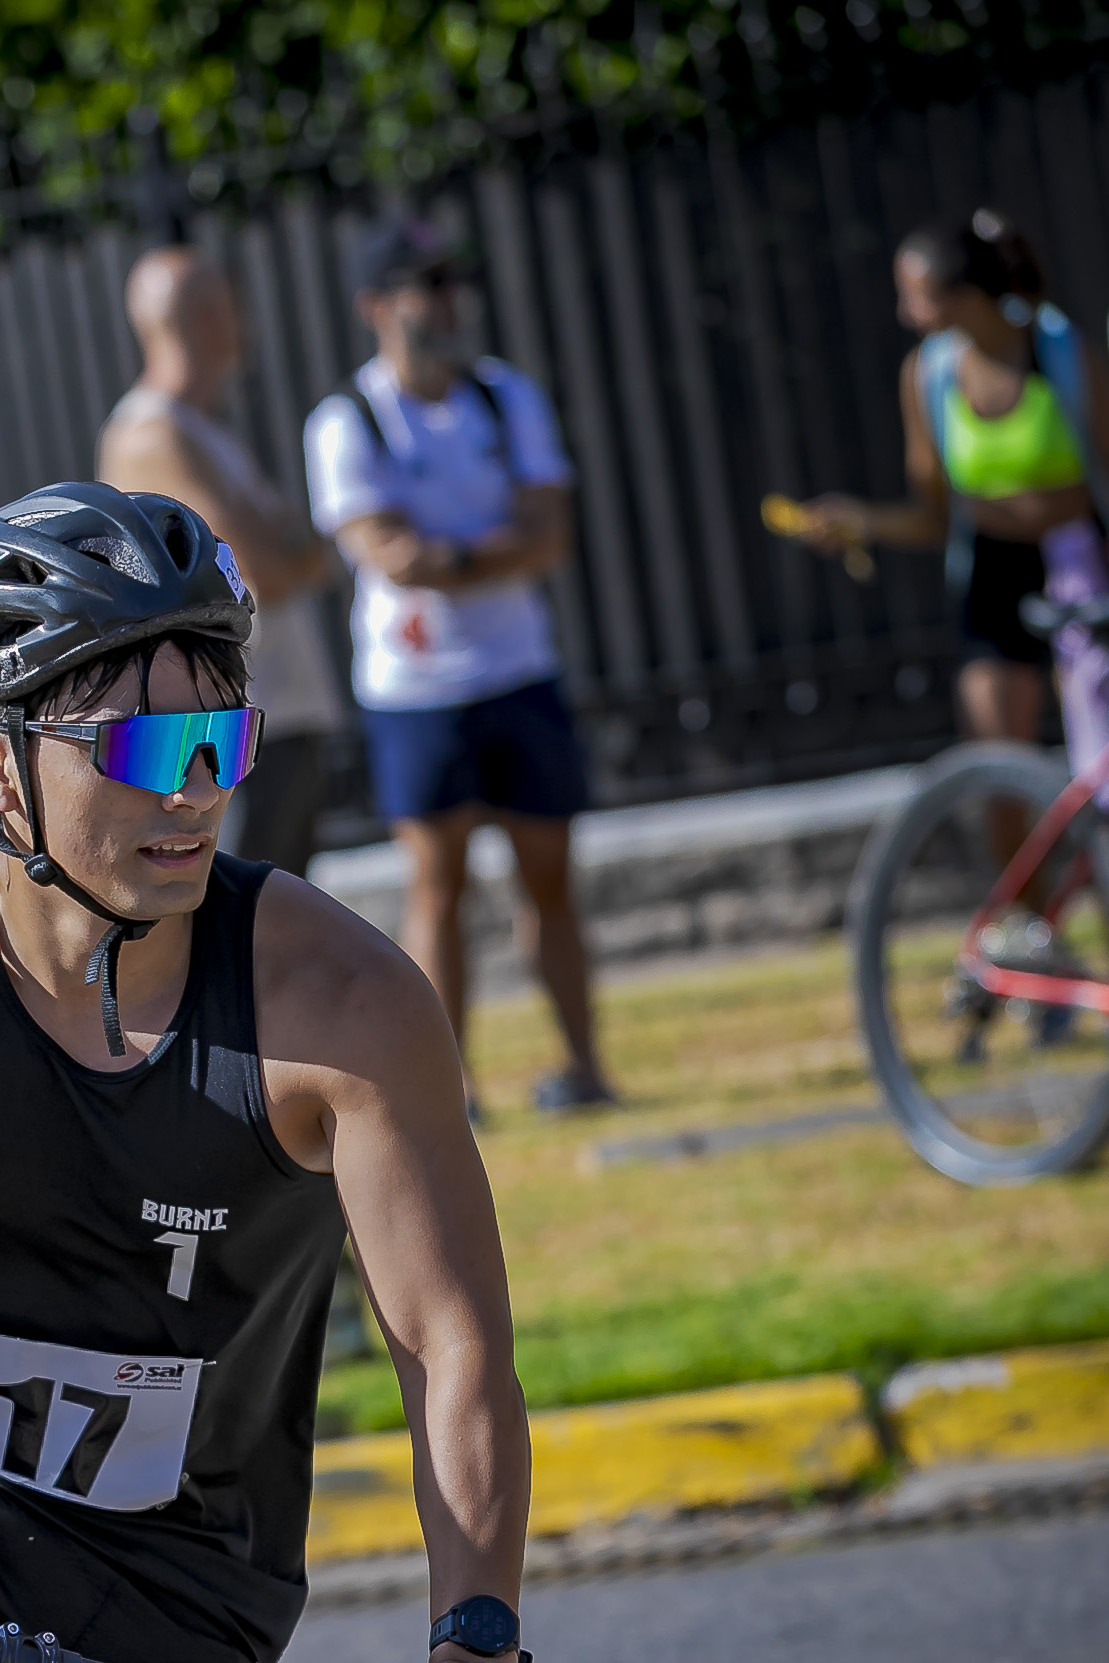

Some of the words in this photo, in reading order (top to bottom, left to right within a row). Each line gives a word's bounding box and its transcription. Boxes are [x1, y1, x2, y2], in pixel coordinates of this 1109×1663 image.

[141, 1198, 229, 1231] BURNI
[153, 1231, 199, 1302] 1
[145, 1363, 184, 1377] sal
